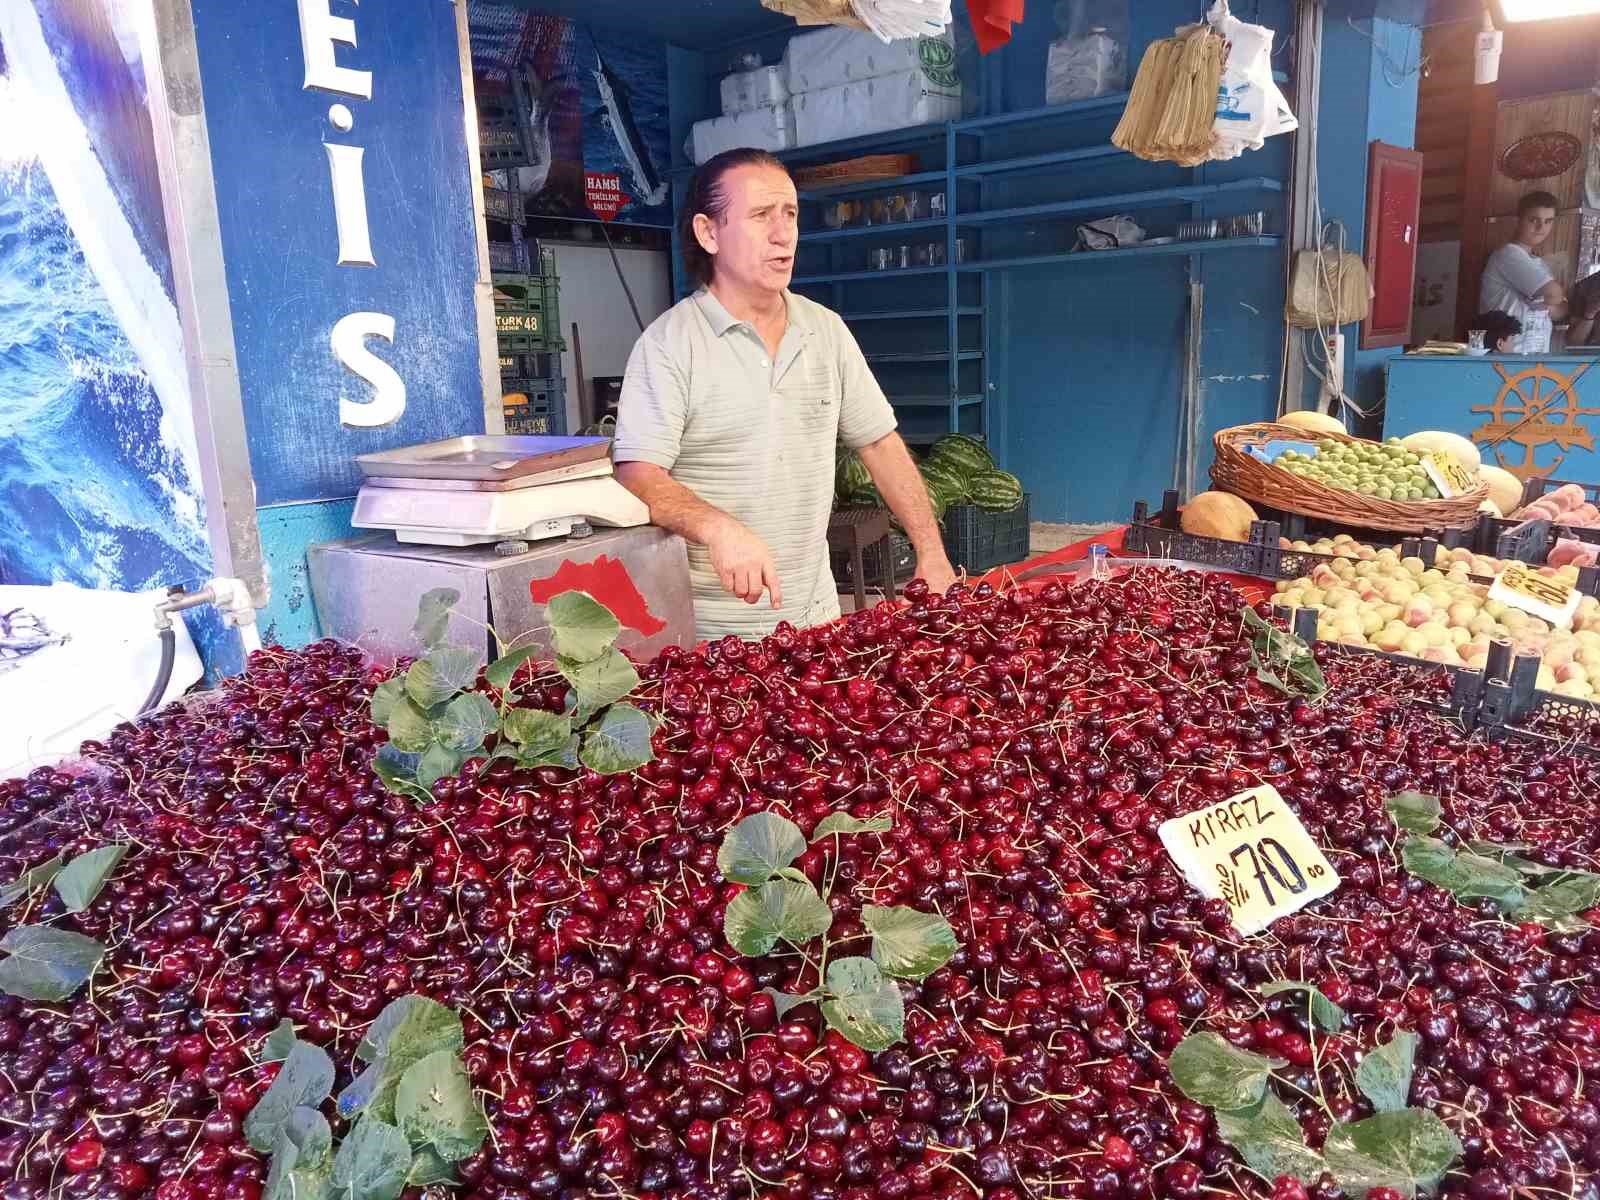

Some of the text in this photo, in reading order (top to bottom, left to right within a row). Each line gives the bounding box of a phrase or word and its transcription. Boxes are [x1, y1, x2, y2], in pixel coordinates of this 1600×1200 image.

[586, 175, 620, 191] HAMSİ
[525, 316, 538, 331] 48
[1188, 795, 1275, 848] KİRAZ
[1229, 837, 1308, 907] 70
